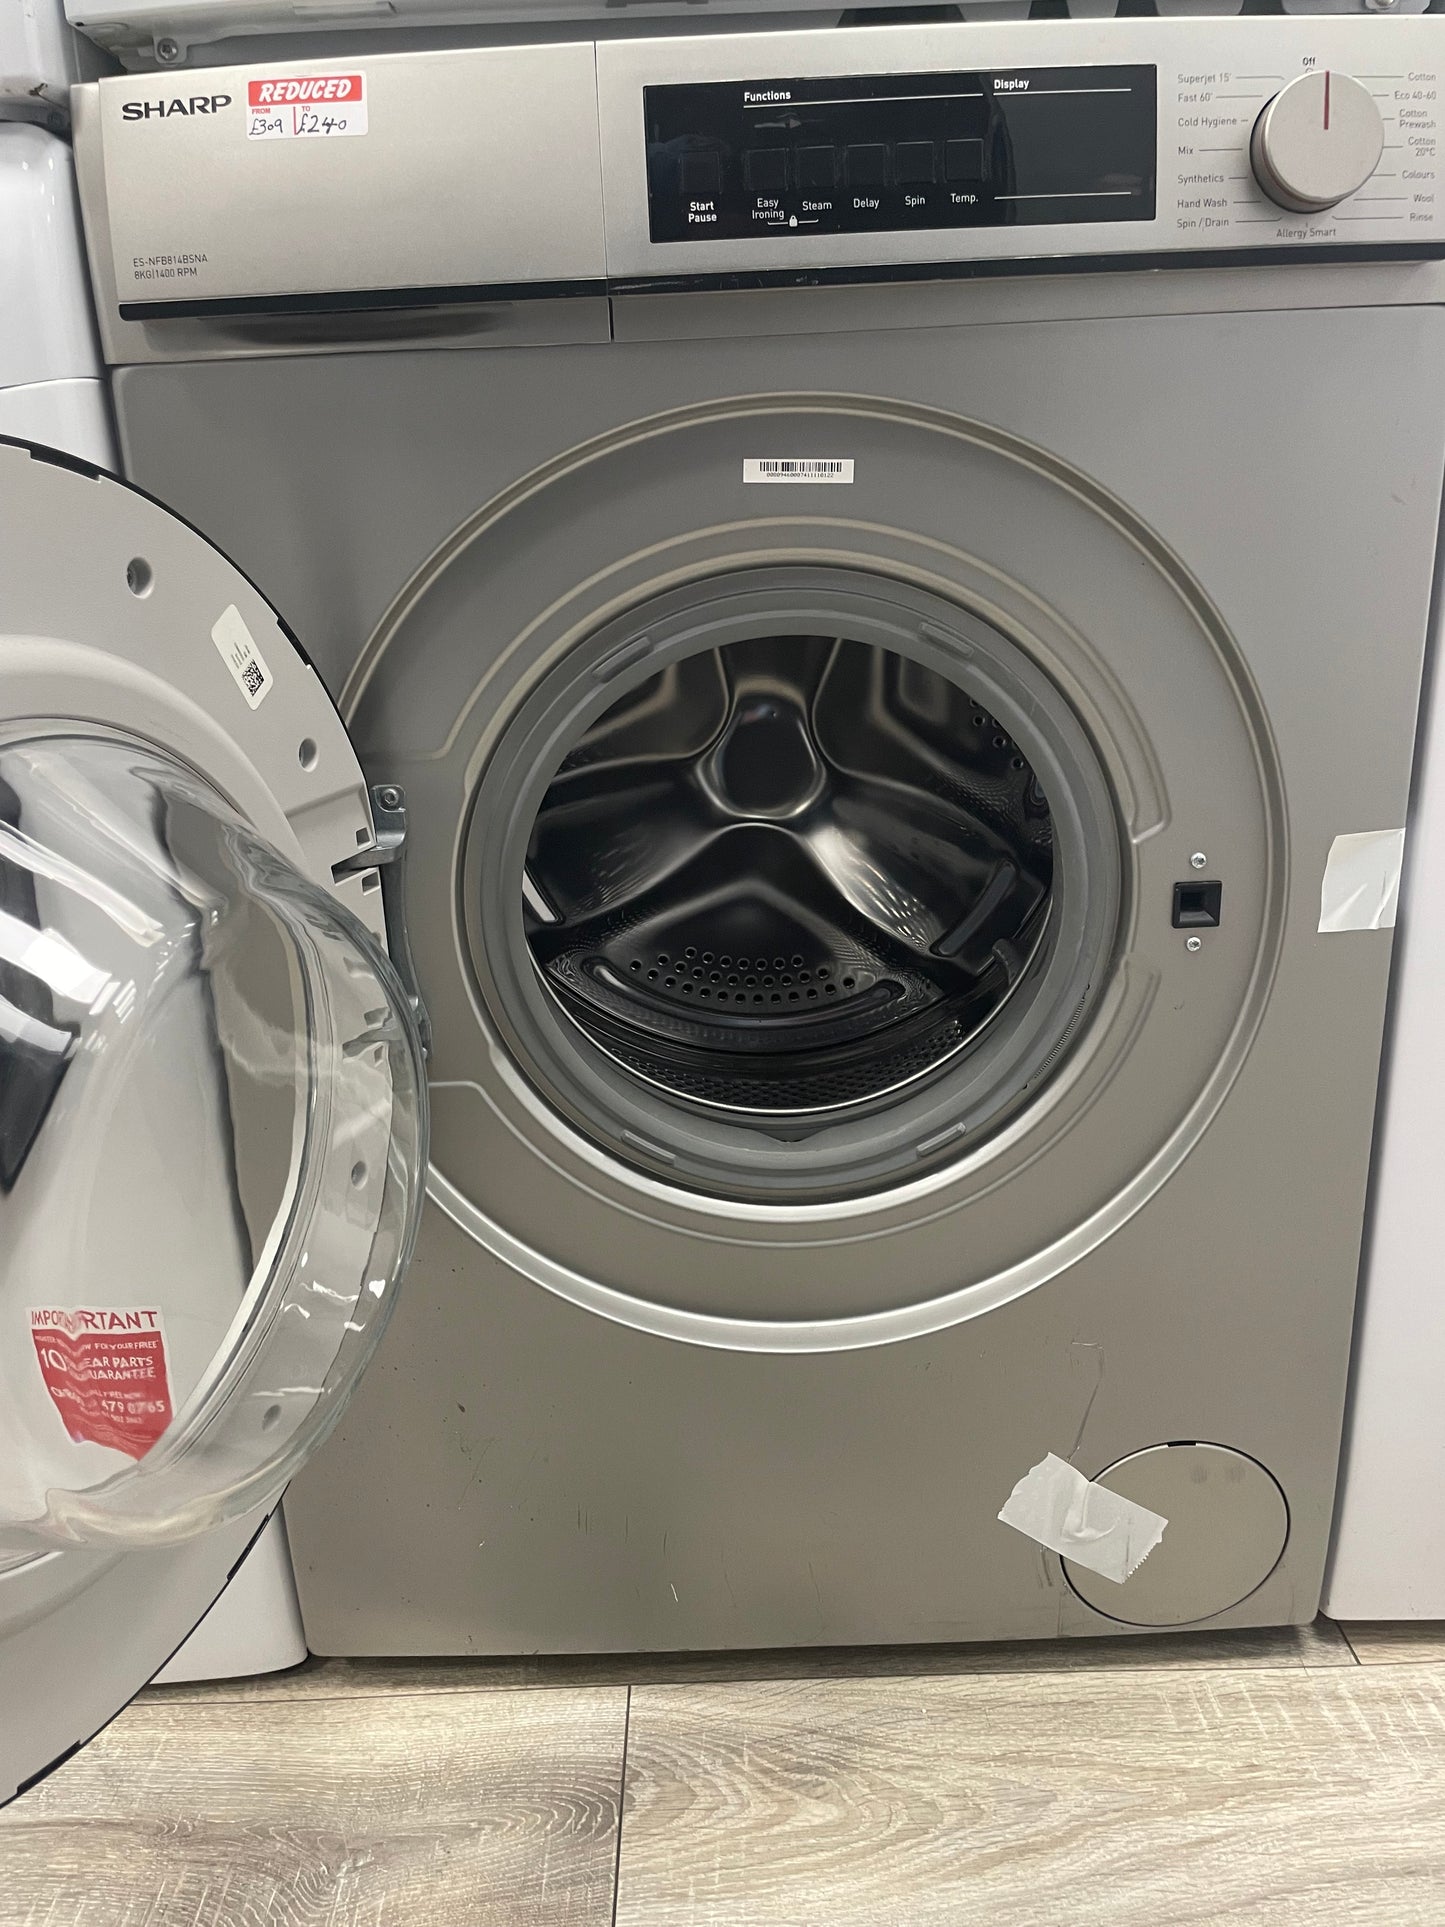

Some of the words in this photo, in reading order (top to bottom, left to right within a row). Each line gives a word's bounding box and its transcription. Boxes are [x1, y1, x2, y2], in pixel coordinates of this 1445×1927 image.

[1302, 56, 1316, 66] Off
[1177, 73, 1216, 85] Superjet
[1408, 71, 1436, 81] Cotton
[993, 77, 1030, 91] Display
[258, 79, 352, 103] REDUCED
[743, 90, 792, 102] Functions
[1394, 90, 1411, 100] Eco
[1412, 90, 1437, 100] 40-60
[1177, 92, 1198, 103] Fast
[122, 94, 232, 121] SHARP
[251, 107, 272, 115] FROM
[301, 105, 311, 113] TO
[1400, 108, 1427, 118] Cotton
[249, 118, 284, 136] £309
[296, 113, 347, 135] £240
[1177, 117, 1199, 127] Cold
[1201, 117, 1237, 129] Hygiene
[1400, 119, 1436, 129] Prewash
[1408, 136, 1436, 146] Cotton
[1177, 146, 1194, 155] Mix
[1415, 147, 1436, 157] 20°C
[1177, 174, 1225, 187] Synthetics
[1402, 169, 1435, 180] Colours
[757, 197, 779, 209] Easy
[853, 197, 880, 210] Delay
[904, 195, 926, 208] Spin
[949, 192, 979, 205] Temp.
[1177, 198, 1201, 209] Hand
[1203, 198, 1228, 208] Wash
[1413, 194, 1434, 203] Wool
[689, 200, 715, 211] Start
[802, 200, 832, 211] Steam
[688, 213, 718, 223] Pause
[751, 208, 785, 220] Ironing
[1409, 212, 1433, 222] Rinse
[1176, 218, 1197, 230] Spin
[1205, 217, 1229, 227] Drain
[1276, 228, 1307, 240] Allergy
[1309, 227, 1336, 238] Smart
[132, 253, 208, 268] ES-NFB814BSNA
[177, 267, 198, 277] RPM
[41, 1348, 67, 1372] 10
[82, 1356, 111, 1369] EAR
[112, 1355, 153, 1369] PARTS
[87, 1366, 157, 1380] UARANTEE
